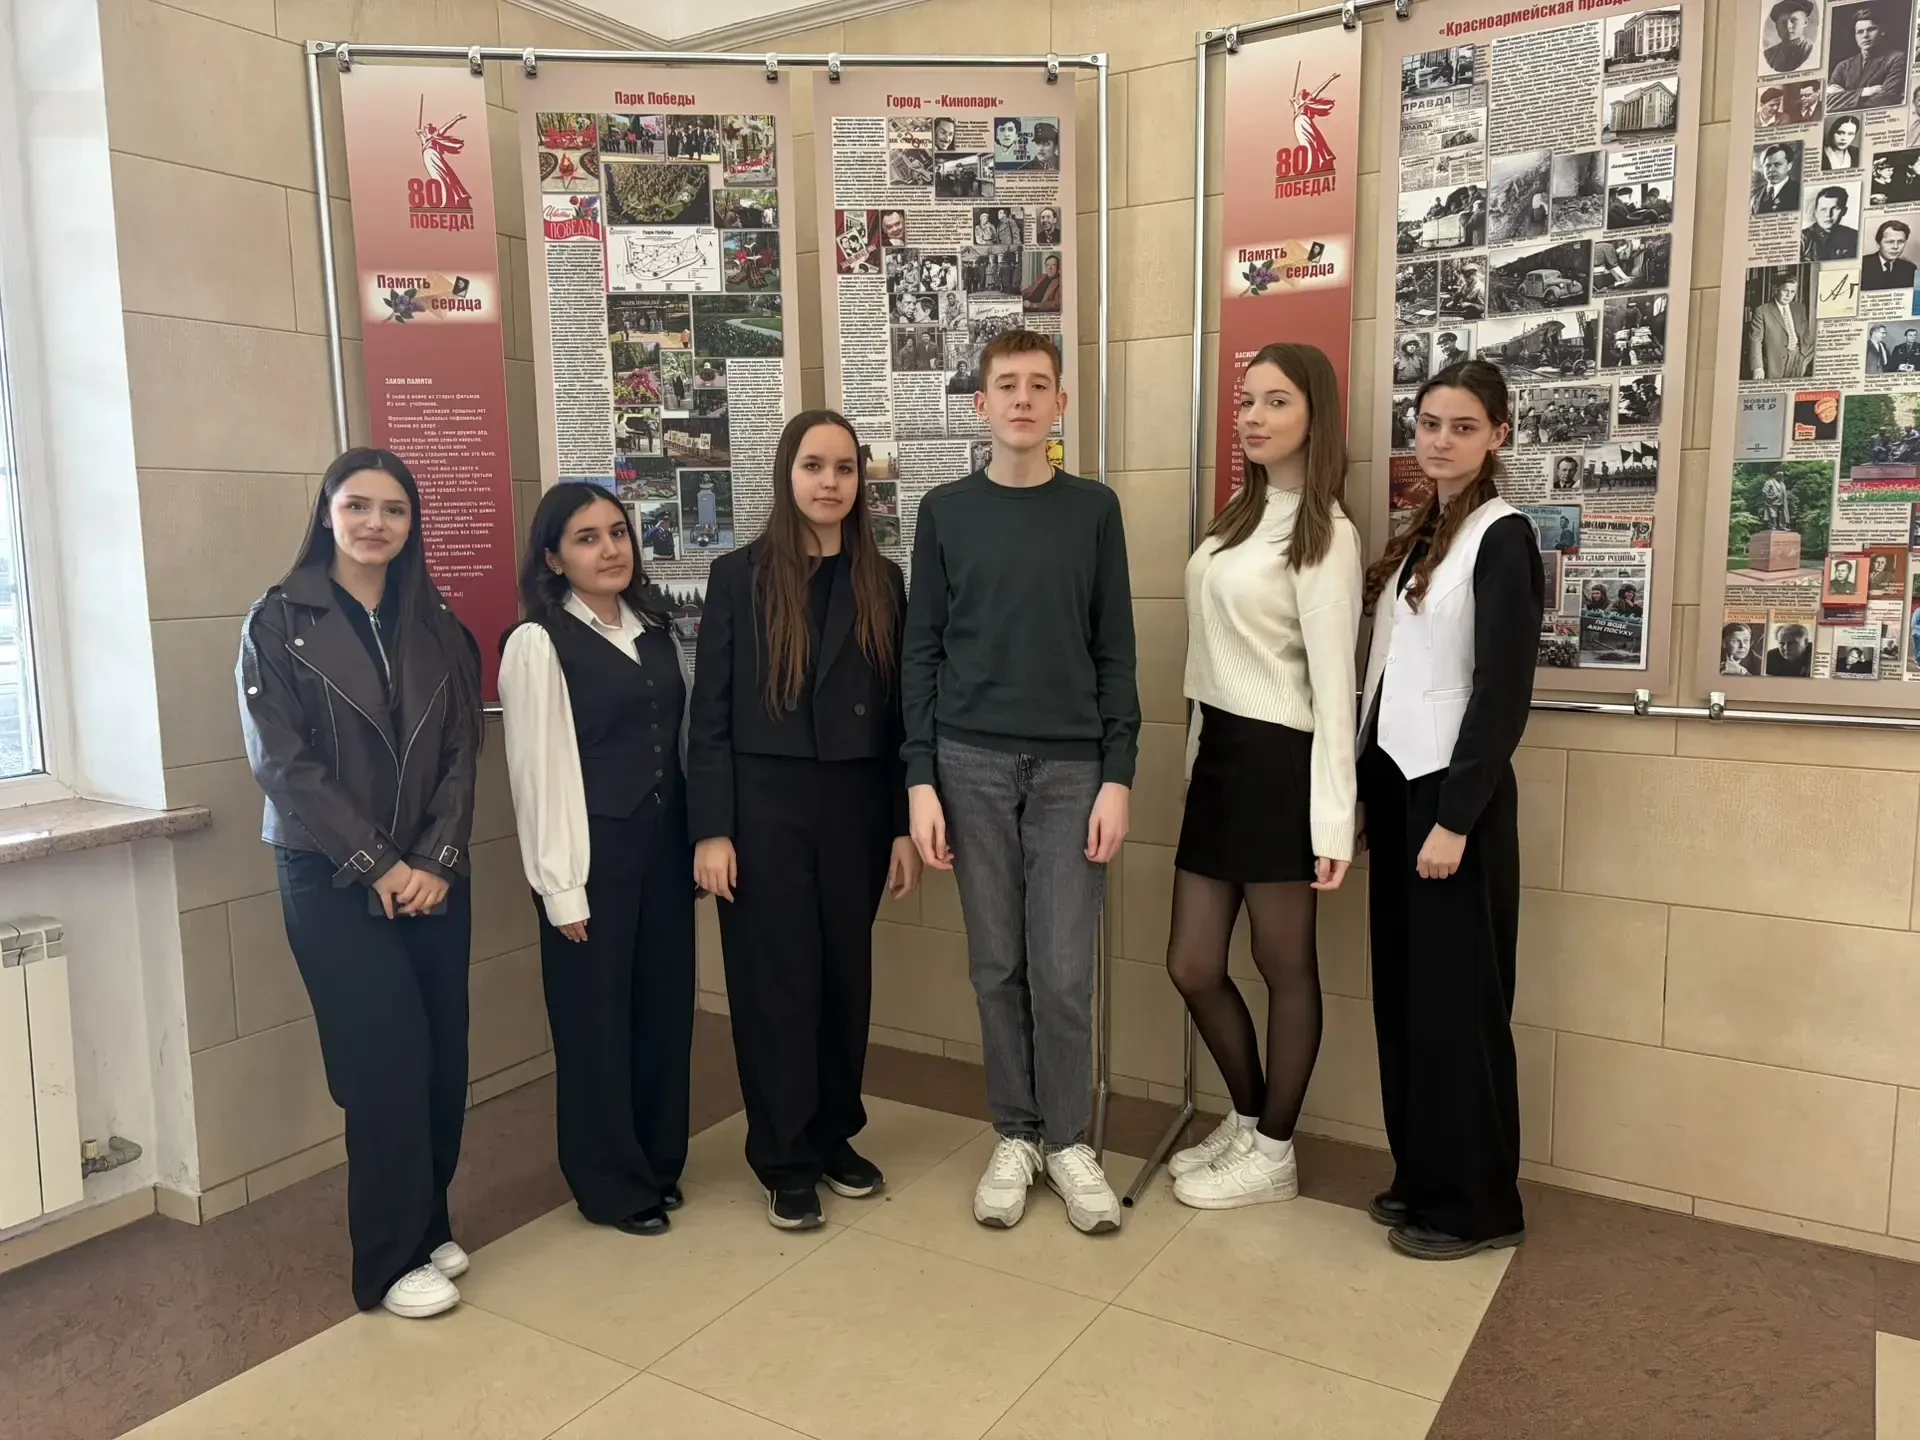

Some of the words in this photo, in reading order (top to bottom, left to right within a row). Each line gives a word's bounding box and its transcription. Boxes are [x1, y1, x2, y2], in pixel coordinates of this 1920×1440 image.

[1439, 1, 1574, 36] «Красноармейская
[1579, 0, 1629, 10] пра
[614, 92, 644, 106] Парк
[648, 92, 696, 107] Победы
[886, 94, 921, 108] Город
[935, 94, 1004, 109] «Кинопарк»
[1402, 96, 1451, 112] ПРАВДА
[1402, 123, 1432, 132] ПРАВДА
[1276, 146, 1308, 178] 80
[408, 178, 442, 208] 80
[1275, 175, 1336, 199] ПОБЕДА!
[410, 213, 474, 231] ПОБЕДА!
[550, 219, 593, 238] ПОБЕДЫ
[1238, 245, 1287, 263] Память
[1286, 261, 1334, 281] сердца
[377, 274, 430, 289] Память
[431, 296, 482, 312] сердца
[1604, 627, 1633, 636] ПОСУХУ
